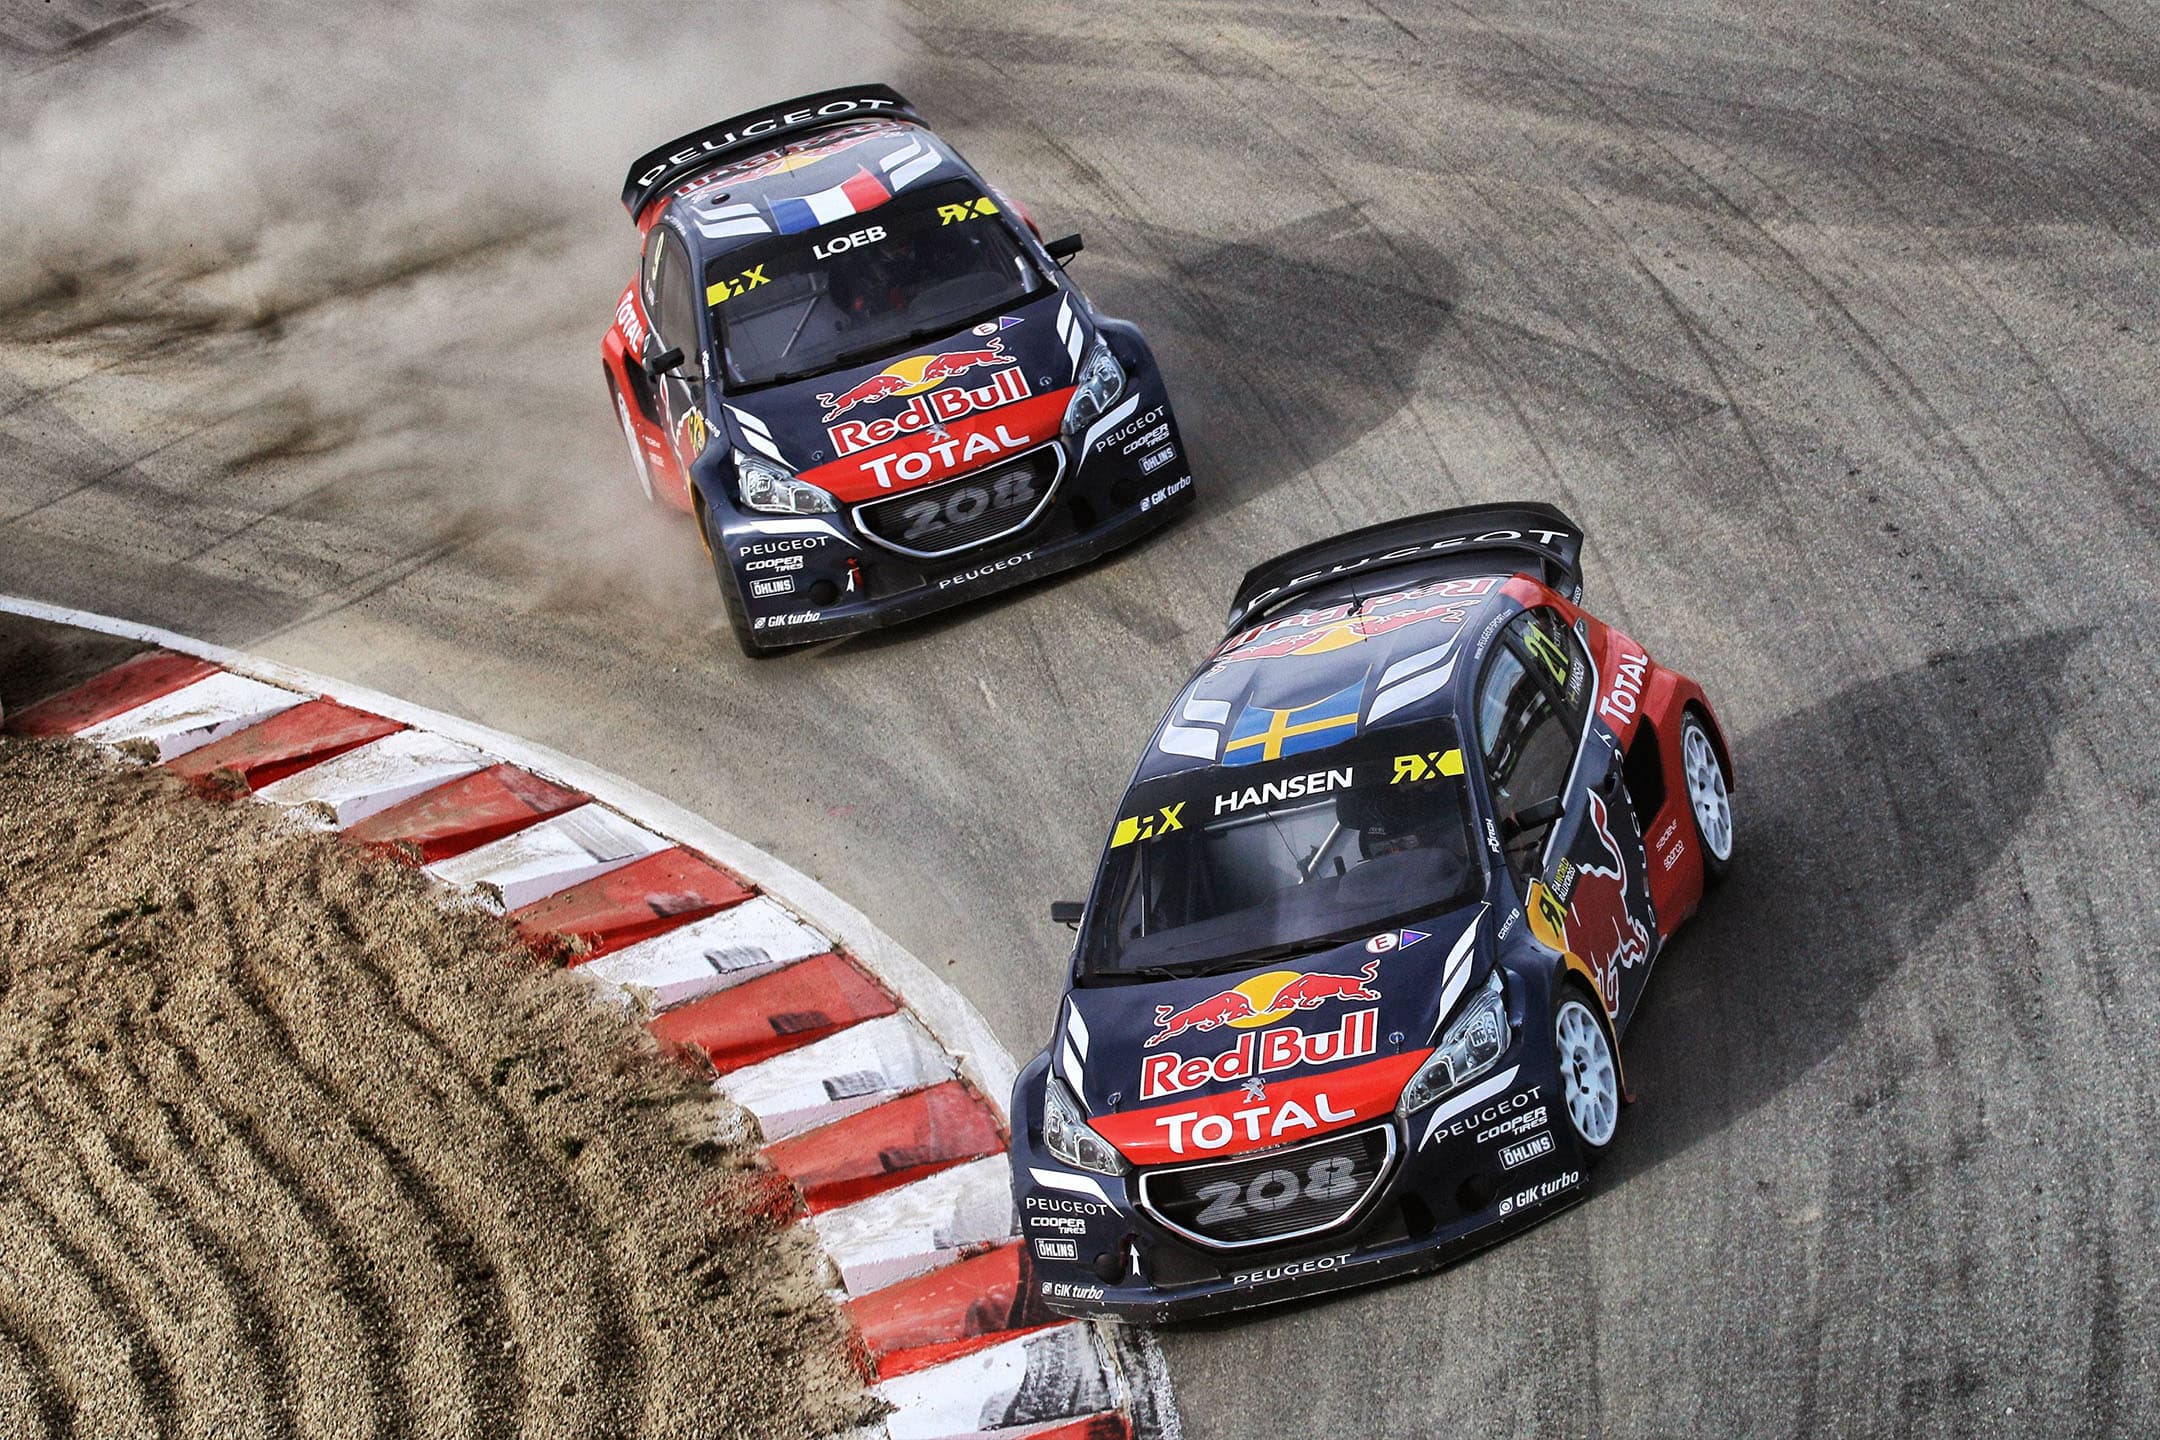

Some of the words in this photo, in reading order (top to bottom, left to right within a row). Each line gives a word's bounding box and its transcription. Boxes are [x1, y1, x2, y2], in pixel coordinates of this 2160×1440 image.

[638, 99, 893, 187] PEUGEOT
[812, 225, 888, 260] LOEB
[615, 290, 643, 353] TOTAL
[828, 397, 935, 457] Red
[929, 366, 1032, 422] Bull
[1096, 405, 1165, 453] PEUGEOT
[1123, 423, 1168, 455] COOPER
[1146, 431, 1170, 448] TIRES
[860, 425, 1030, 488] TOTAL
[1142, 447, 1174, 472] ÖHLINS
[1167, 475, 1192, 496] turbo
[902, 471, 1036, 540] 208
[740, 536, 829, 557] PEUGEOT
[746, 555, 803, 571] COOPER
[775, 563, 803, 572] TIRES
[939, 551, 1035, 590] PEUGEOT
[753, 580, 792, 595] ÖHLINS
[787, 610, 820, 625] turbo
[1523, 620, 1569, 687] 21
[1600, 653, 1649, 725] TOTAL
[1214, 767, 1354, 816] HANSEN
[1139, 1031, 1256, 1100] Red
[1258, 1007, 1379, 1074] Bull
[1155, 1093, 1356, 1154] TOTAL
[1434, 1086, 1541, 1143] PEUGEOT
[1476, 1106, 1546, 1143] COOPER
[1512, 1115, 1548, 1136] TIRES
[1504, 1136, 1551, 1165] ÖHLINS
[1196, 1156, 1358, 1225] 208
[1541, 1170, 1579, 1197] turbo
[1026, 1198, 1107, 1216] PEUGEOT
[1031, 1217, 1085, 1227] COOPER
[1058, 1226, 1086, 1235] TIRES
[1038, 1240, 1074, 1257] ÖHLINS
[1233, 1253, 1351, 1286] PEUGEOT
[1072, 1284, 1104, 1300] turbo
